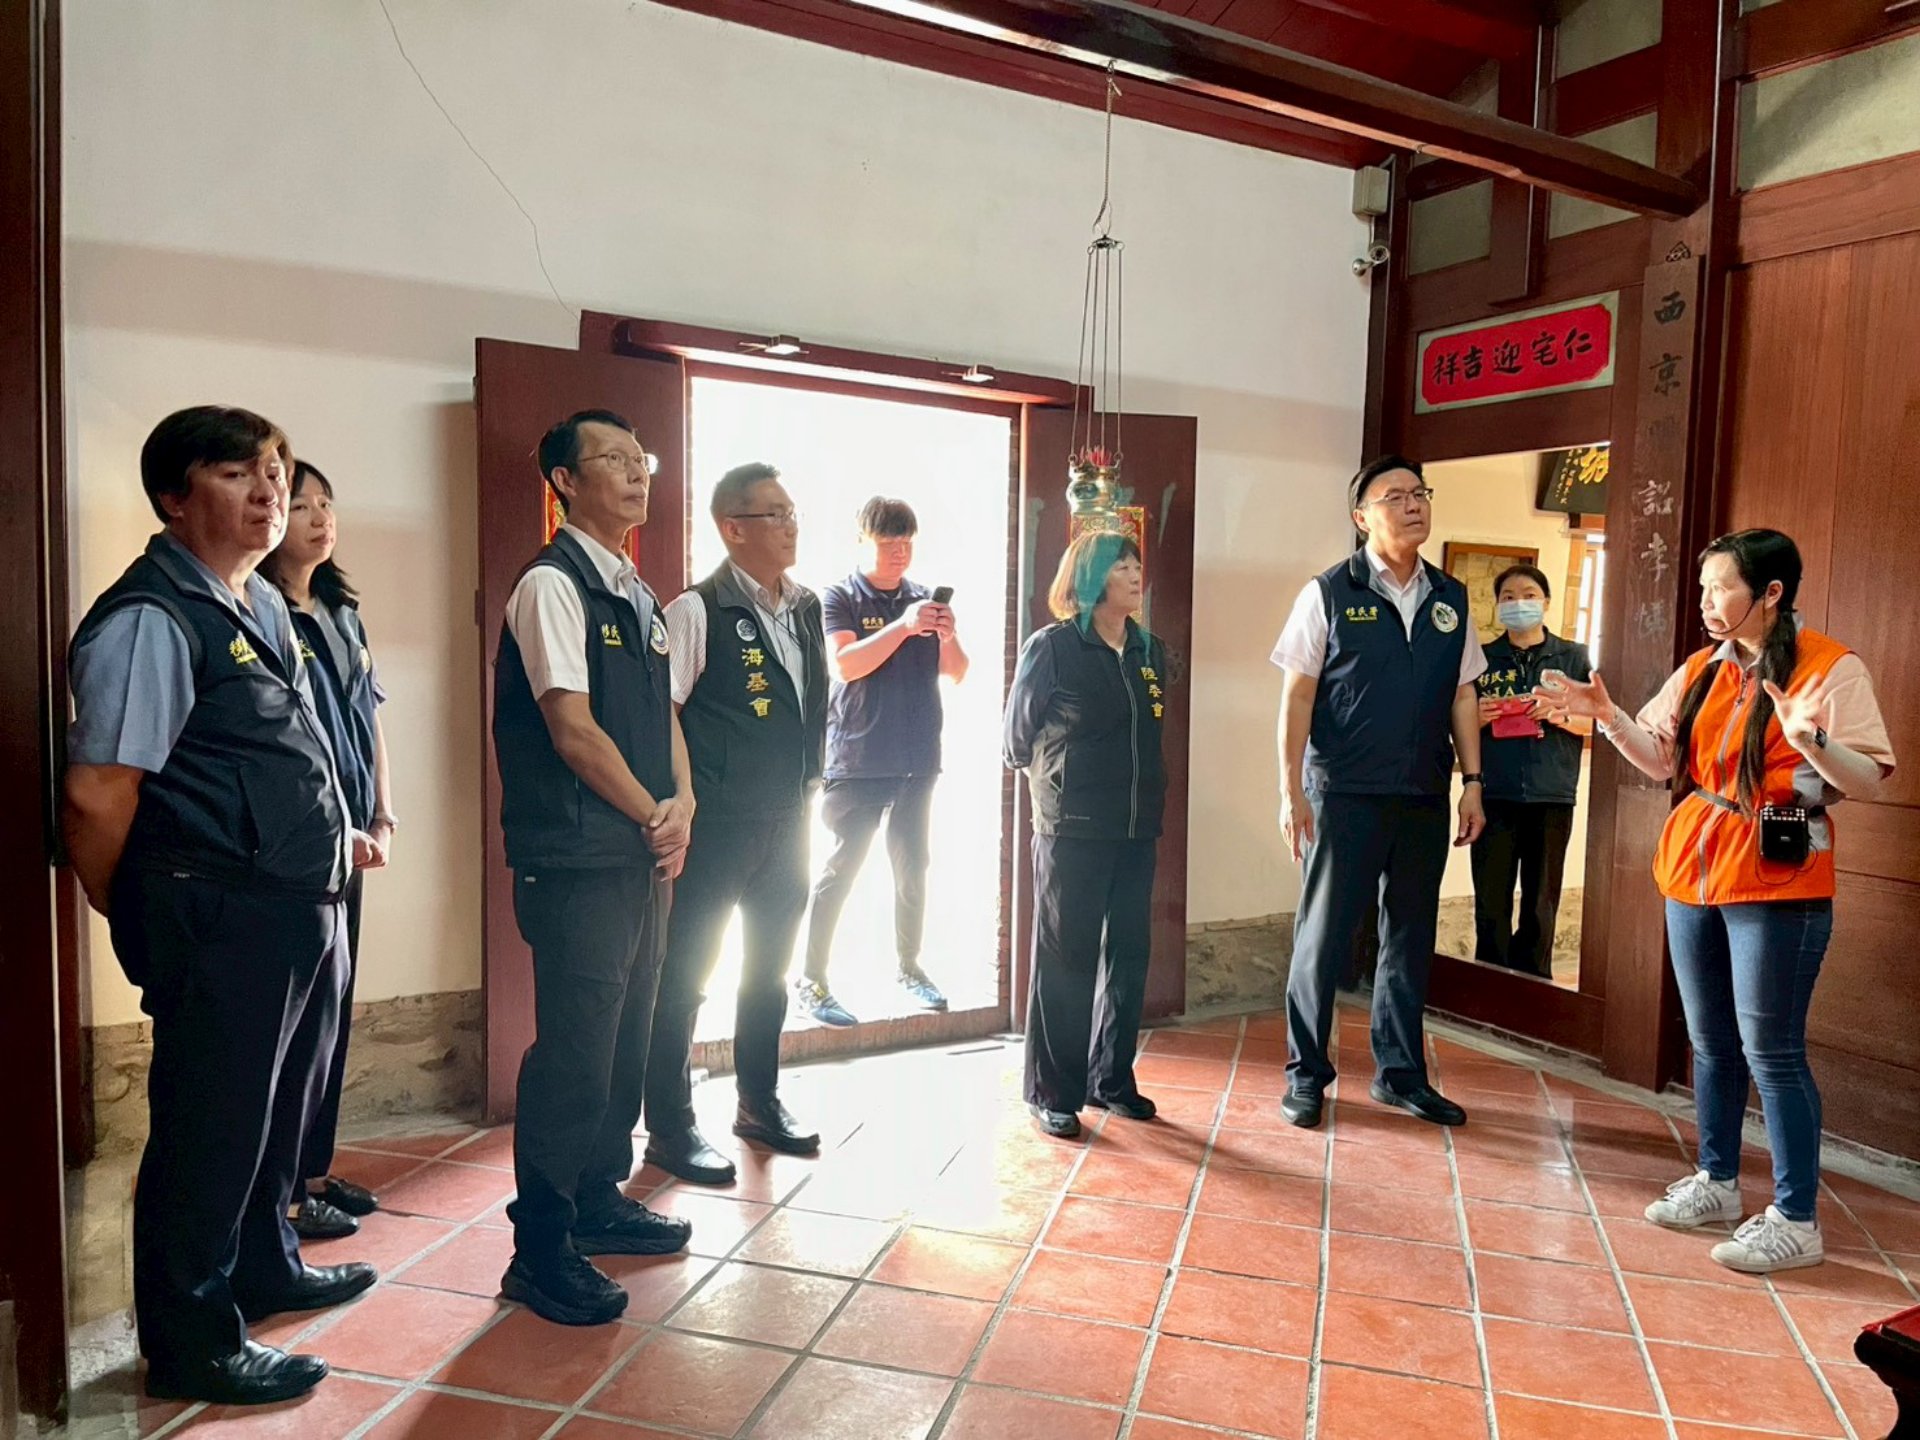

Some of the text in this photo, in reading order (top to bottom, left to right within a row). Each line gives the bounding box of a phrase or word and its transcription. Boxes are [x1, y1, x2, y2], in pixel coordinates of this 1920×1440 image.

[1432, 328, 1593, 385] 仁宅迎吉祥
[741, 648, 772, 717] 海基會
